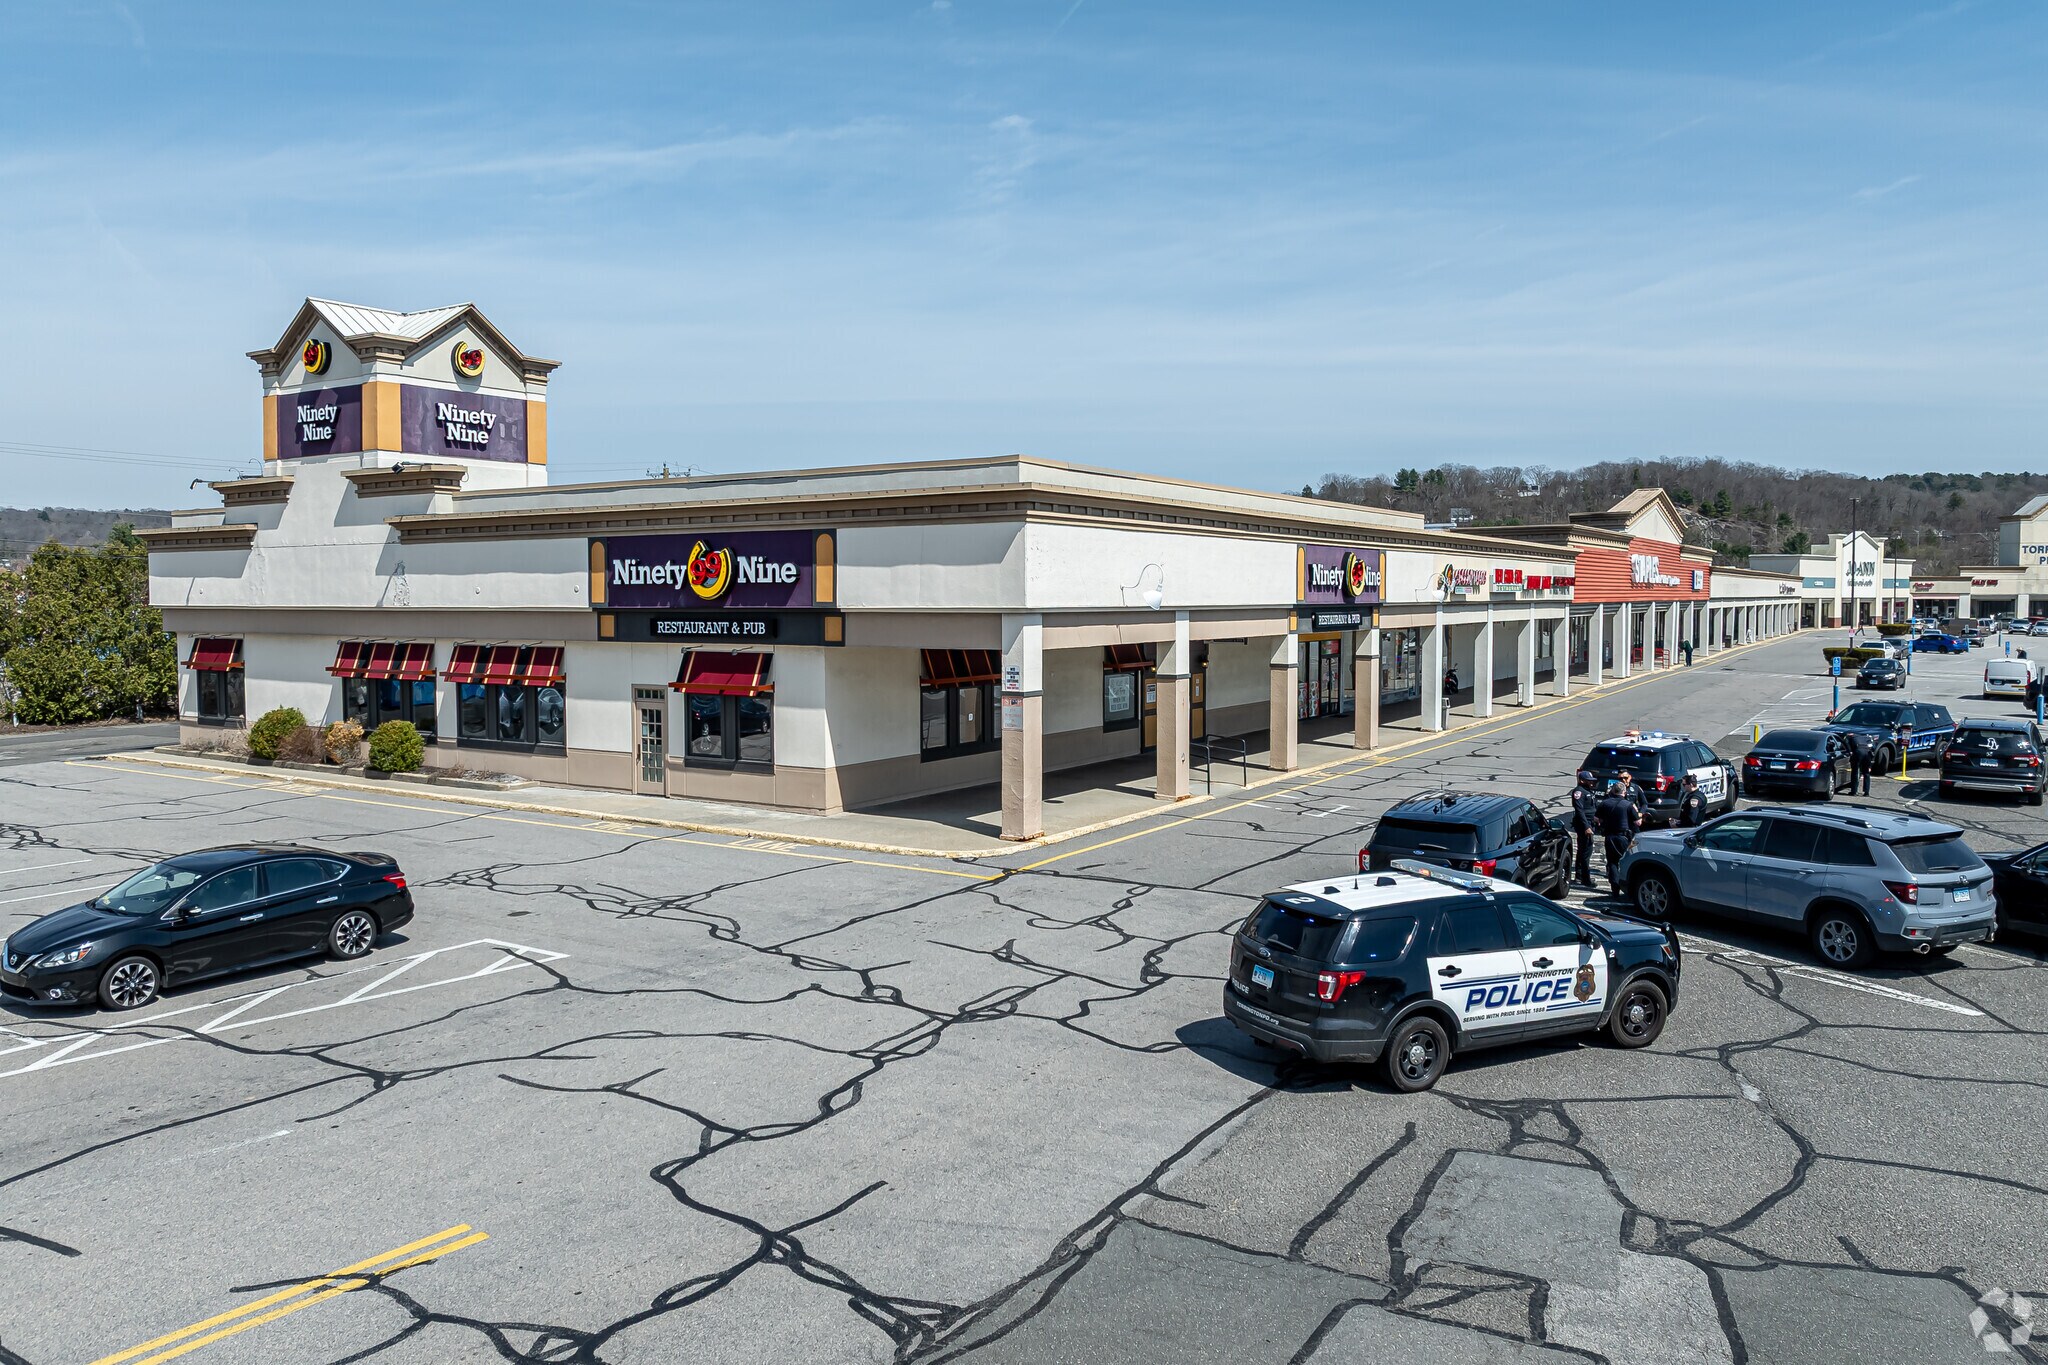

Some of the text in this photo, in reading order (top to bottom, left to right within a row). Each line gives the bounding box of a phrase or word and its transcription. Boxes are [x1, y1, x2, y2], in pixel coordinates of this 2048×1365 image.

[297, 405, 337, 423] Ninety
[437, 402, 497, 429] Ninety
[302, 424, 332, 441] Nine
[446, 423, 489, 444] Nine
[612, 551, 797, 590] Ninety 99 Nine
[1312, 563, 1345, 589] Ninety
[1363, 566, 1381, 586] Nine
[657, 621, 766, 635] RESTAURANT & PUB
[1318, 614, 1347, 626] RESTAURANT
[1351, 614, 1360, 624] PUB
[1909, 734, 1937, 748] OLICE
[1459, 860, 1469, 869] 6
[1609, 949, 1616, 958] 2
[1522, 968, 1575, 979] TORRINGTON
[1231, 977, 1250, 994] POLICE
[1465, 977, 1572, 1013] POLICE
[1463, 1014, 1485, 1023] SERVING
